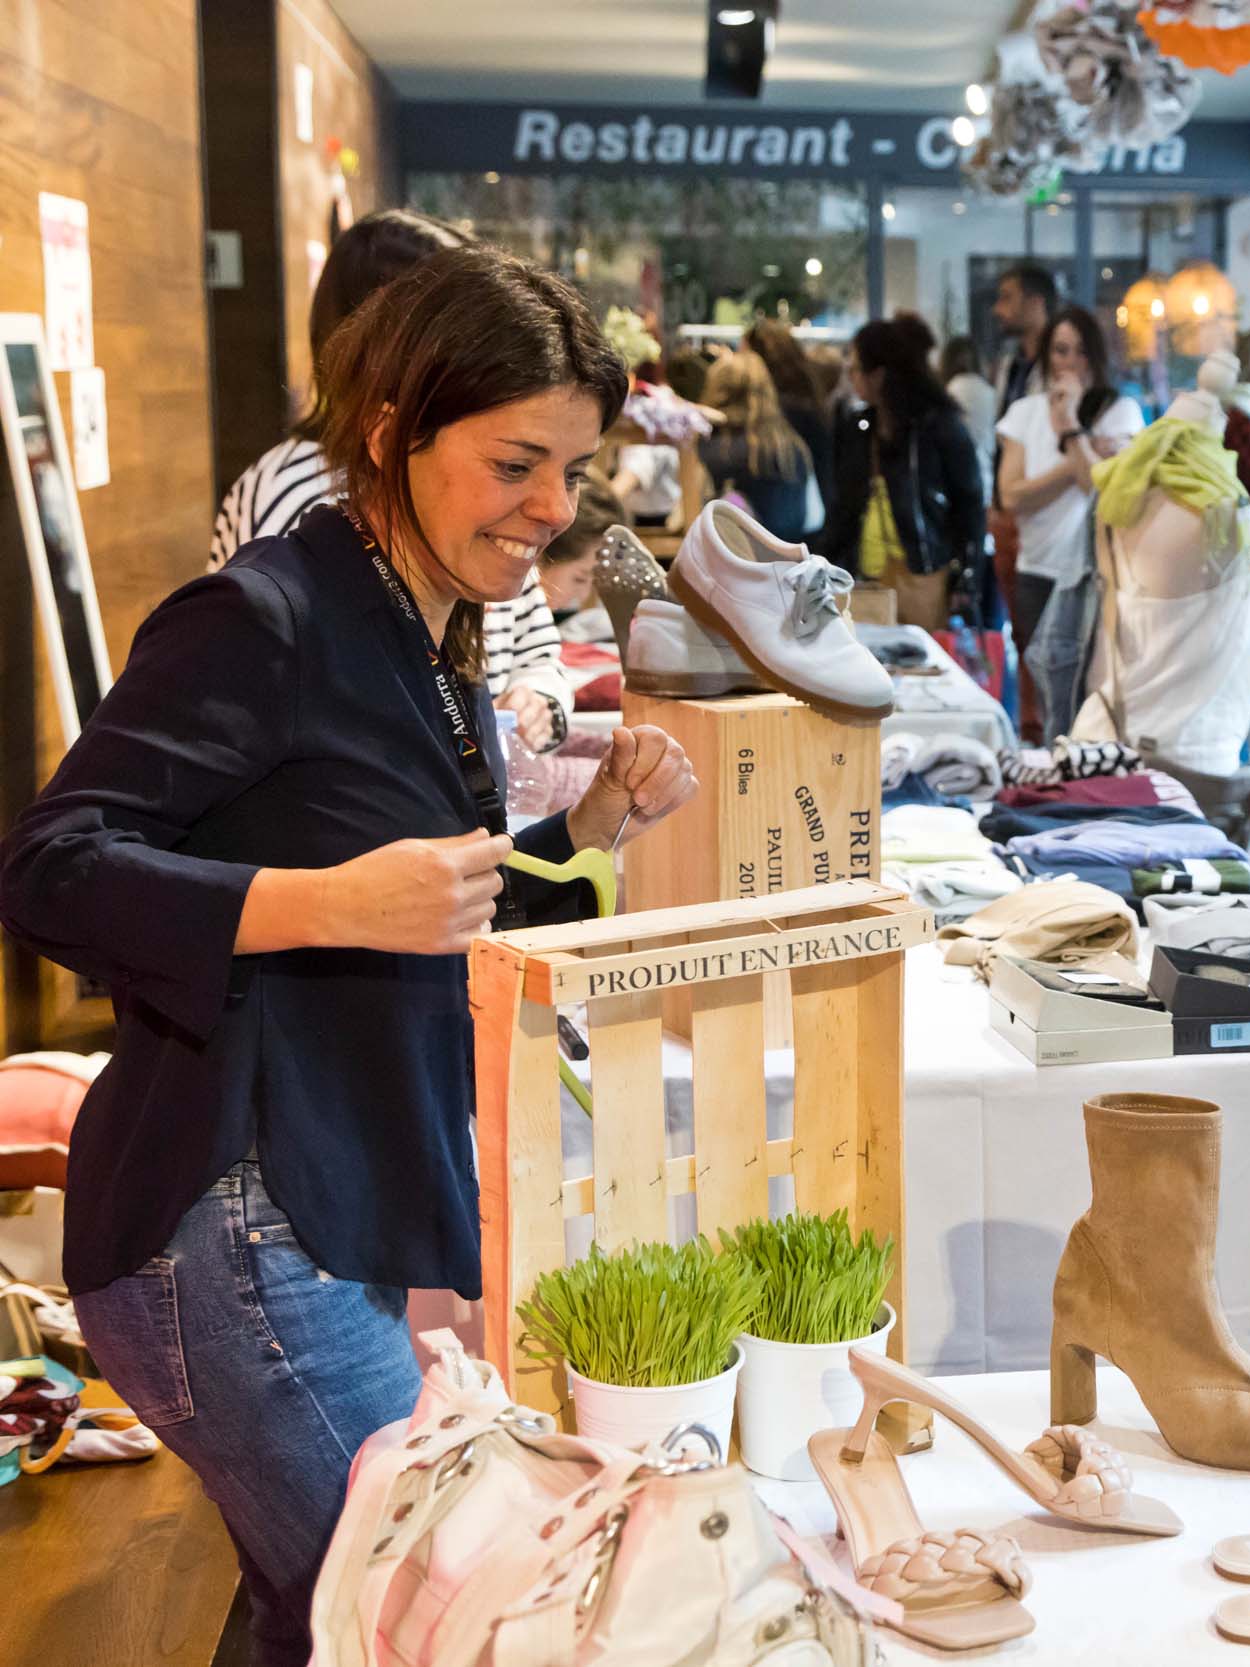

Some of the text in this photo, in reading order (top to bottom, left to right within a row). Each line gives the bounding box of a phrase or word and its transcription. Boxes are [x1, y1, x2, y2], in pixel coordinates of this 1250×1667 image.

[514, 110, 853, 166] Restaurant
[435, 674, 469, 735] Andorra
[738, 748, 754, 758] 6
[767, 826, 783, 894] PAUIL
[795, 785, 830, 883] GRAND PUY
[739, 862, 757, 899] 201
[588, 926, 902, 997] PRODUIT EN FRANCE
